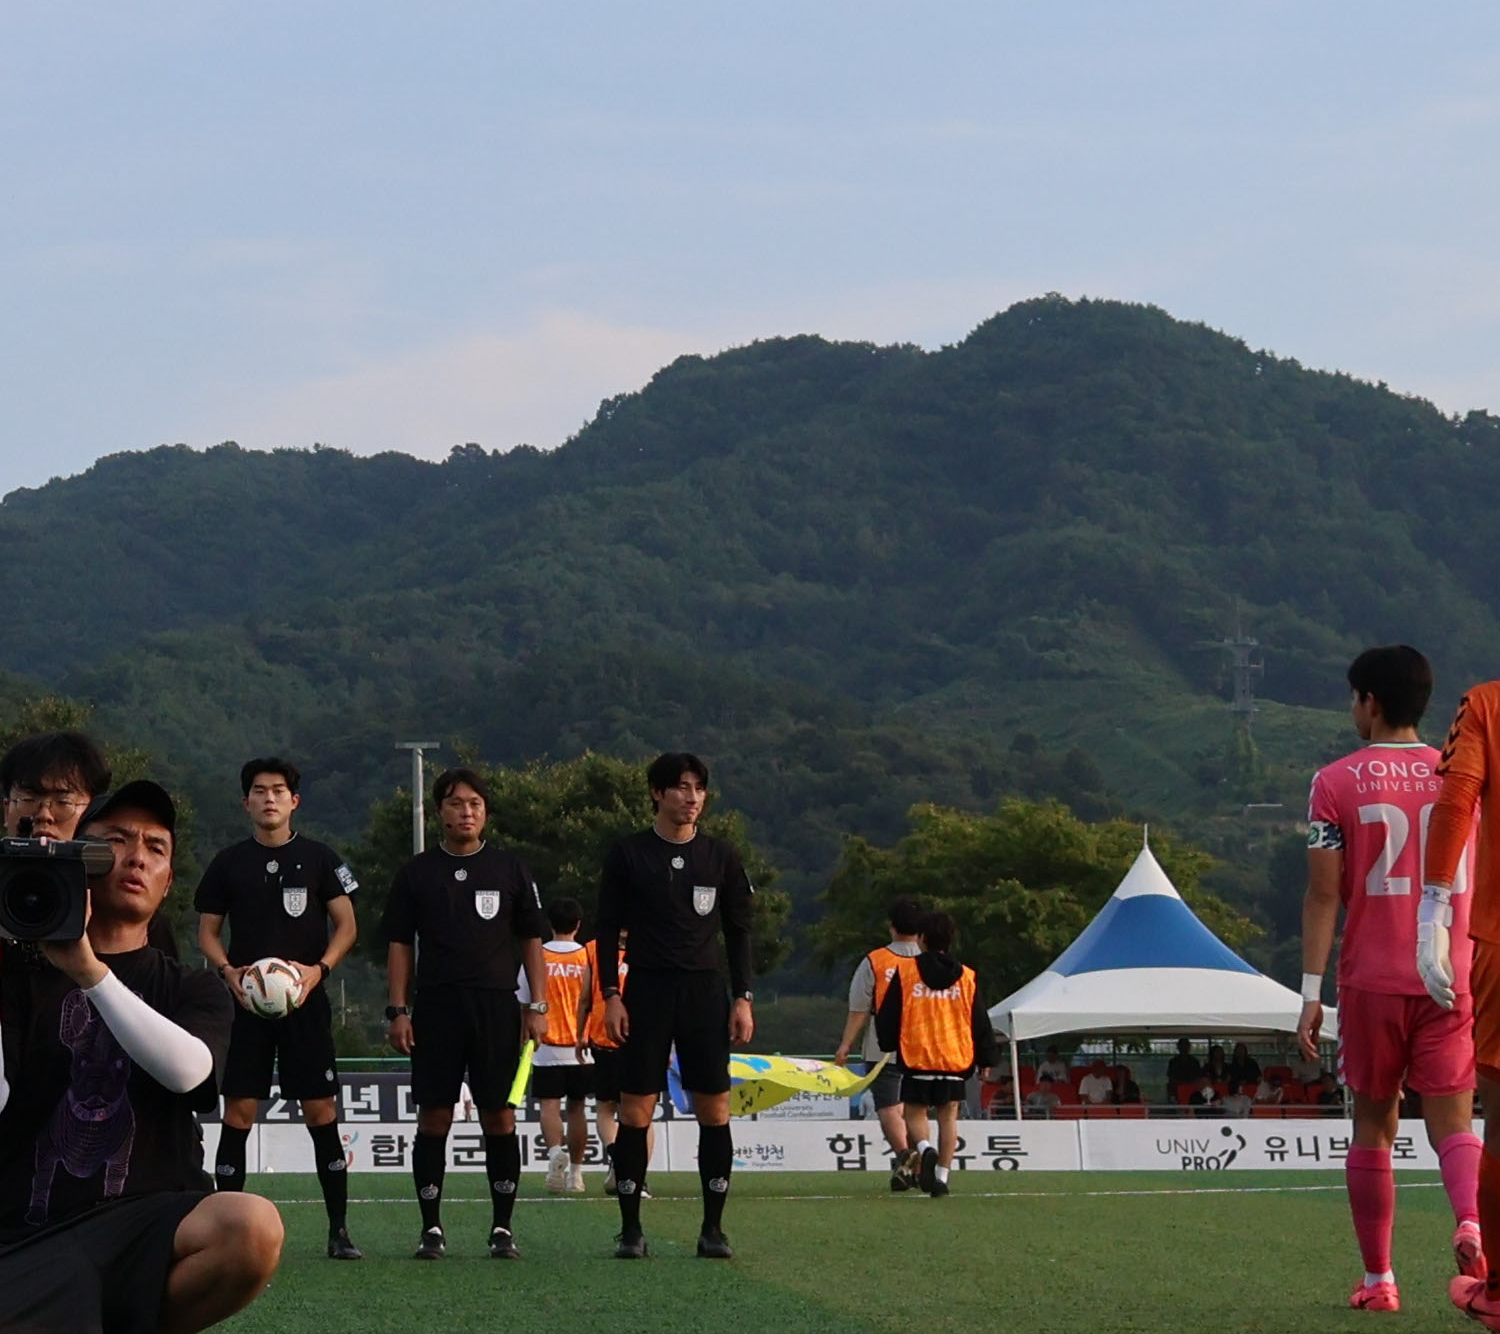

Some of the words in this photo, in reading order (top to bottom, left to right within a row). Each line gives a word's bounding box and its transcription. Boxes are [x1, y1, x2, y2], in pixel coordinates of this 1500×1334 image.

[1347, 760, 1430, 780] YONG
[1356, 780, 1443, 794] UNIVERS
[546, 962, 585, 978] TAFF
[1156, 1138, 1211, 1154] UNIV
[1264, 1135, 1417, 1162] 유니브로
[1181, 1155, 1221, 1170] PRO
